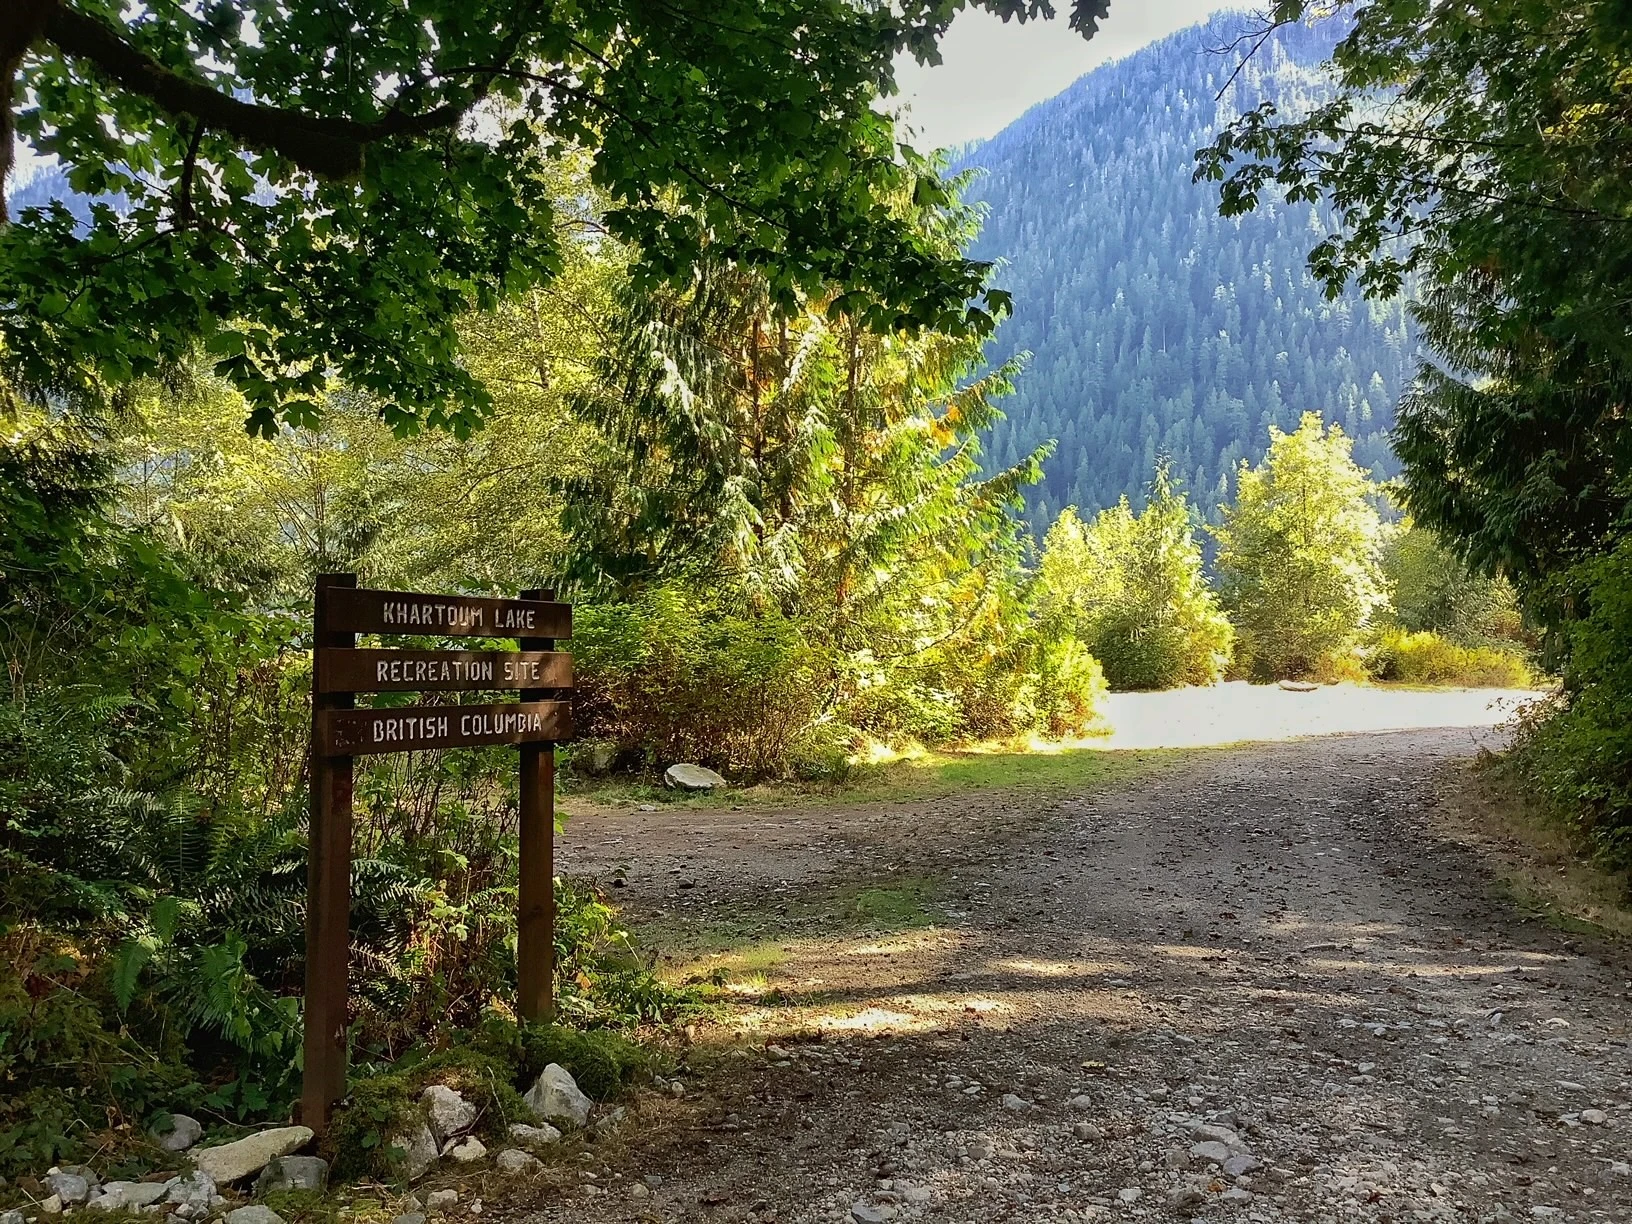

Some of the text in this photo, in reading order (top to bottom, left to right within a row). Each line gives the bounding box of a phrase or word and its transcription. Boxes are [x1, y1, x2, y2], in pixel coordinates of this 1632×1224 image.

[384, 602, 536, 629] KHARTOUM LAKE
[377, 661, 540, 682] RECREATION SITE
[373, 713, 542, 742] BRITISH COLUMBIA
